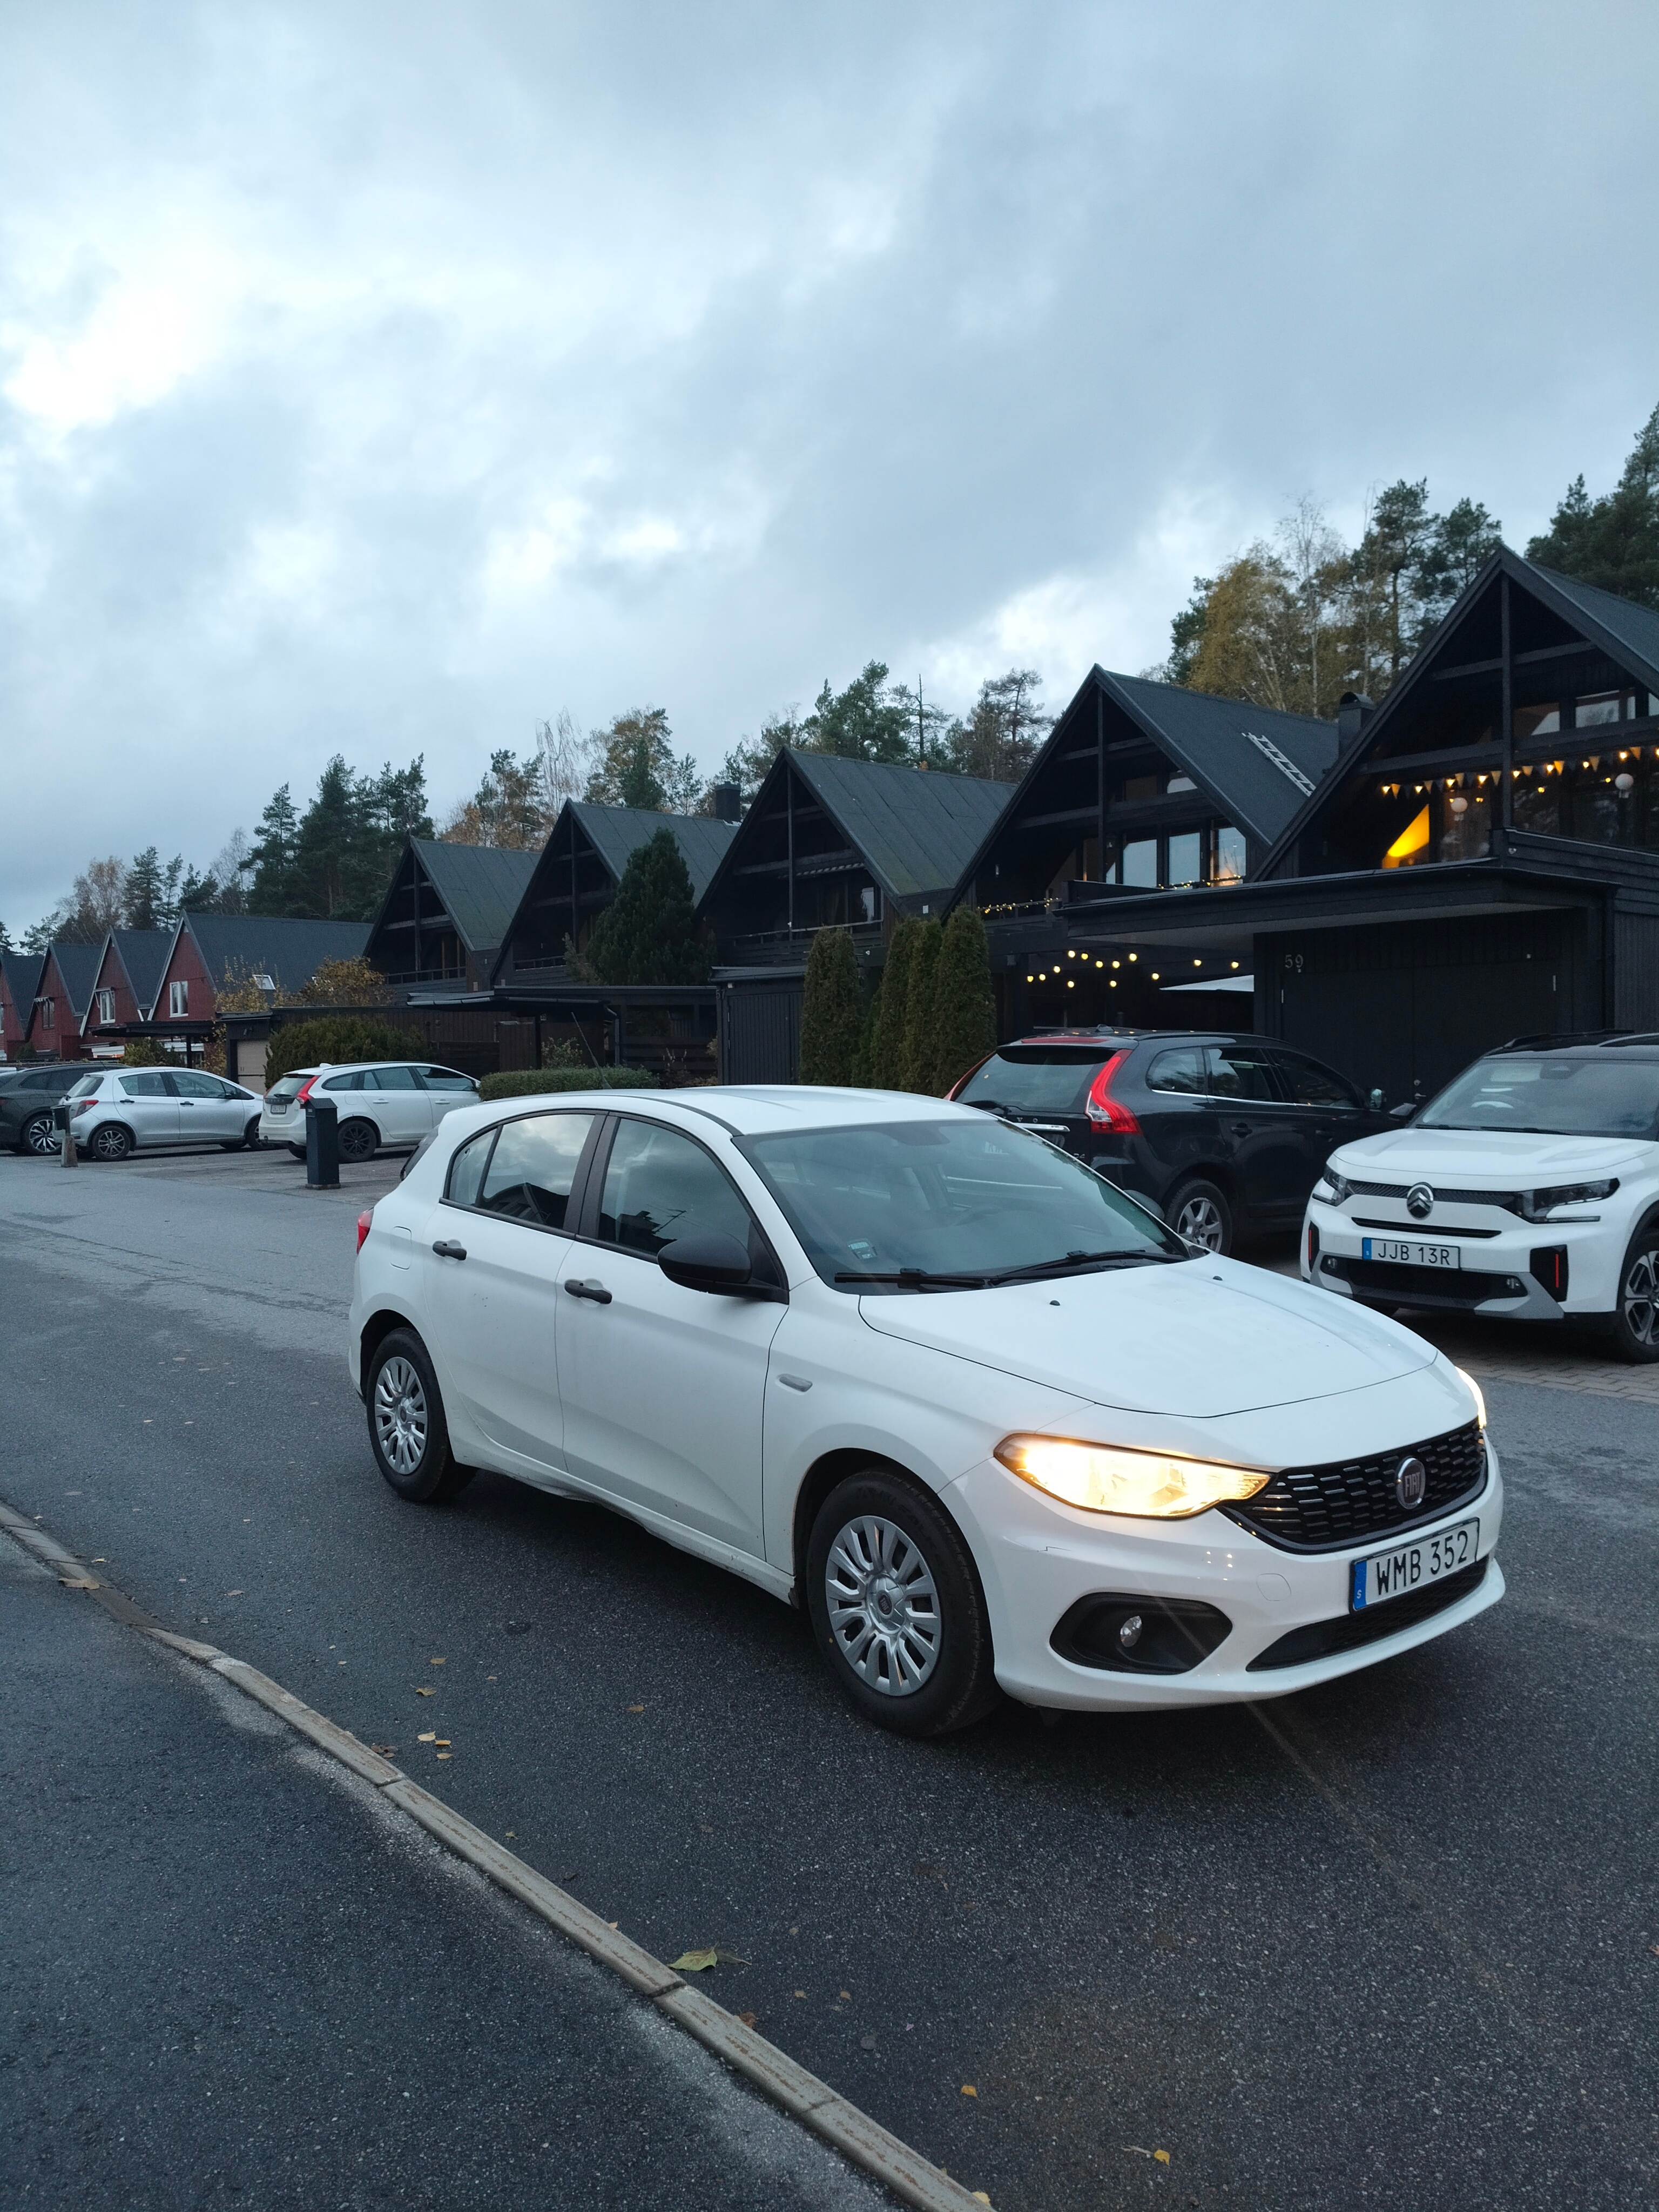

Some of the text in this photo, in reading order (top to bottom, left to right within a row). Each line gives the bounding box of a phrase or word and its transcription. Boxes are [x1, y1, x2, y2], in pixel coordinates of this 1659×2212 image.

[1285, 954, 1304, 969] 59
[1378, 1243, 1410, 1260] JJB
[1418, 1247, 1451, 1265] 13R
[1404, 1472, 1421, 1498] FIAT
[1356, 1530, 1468, 1599] S WMB 352
